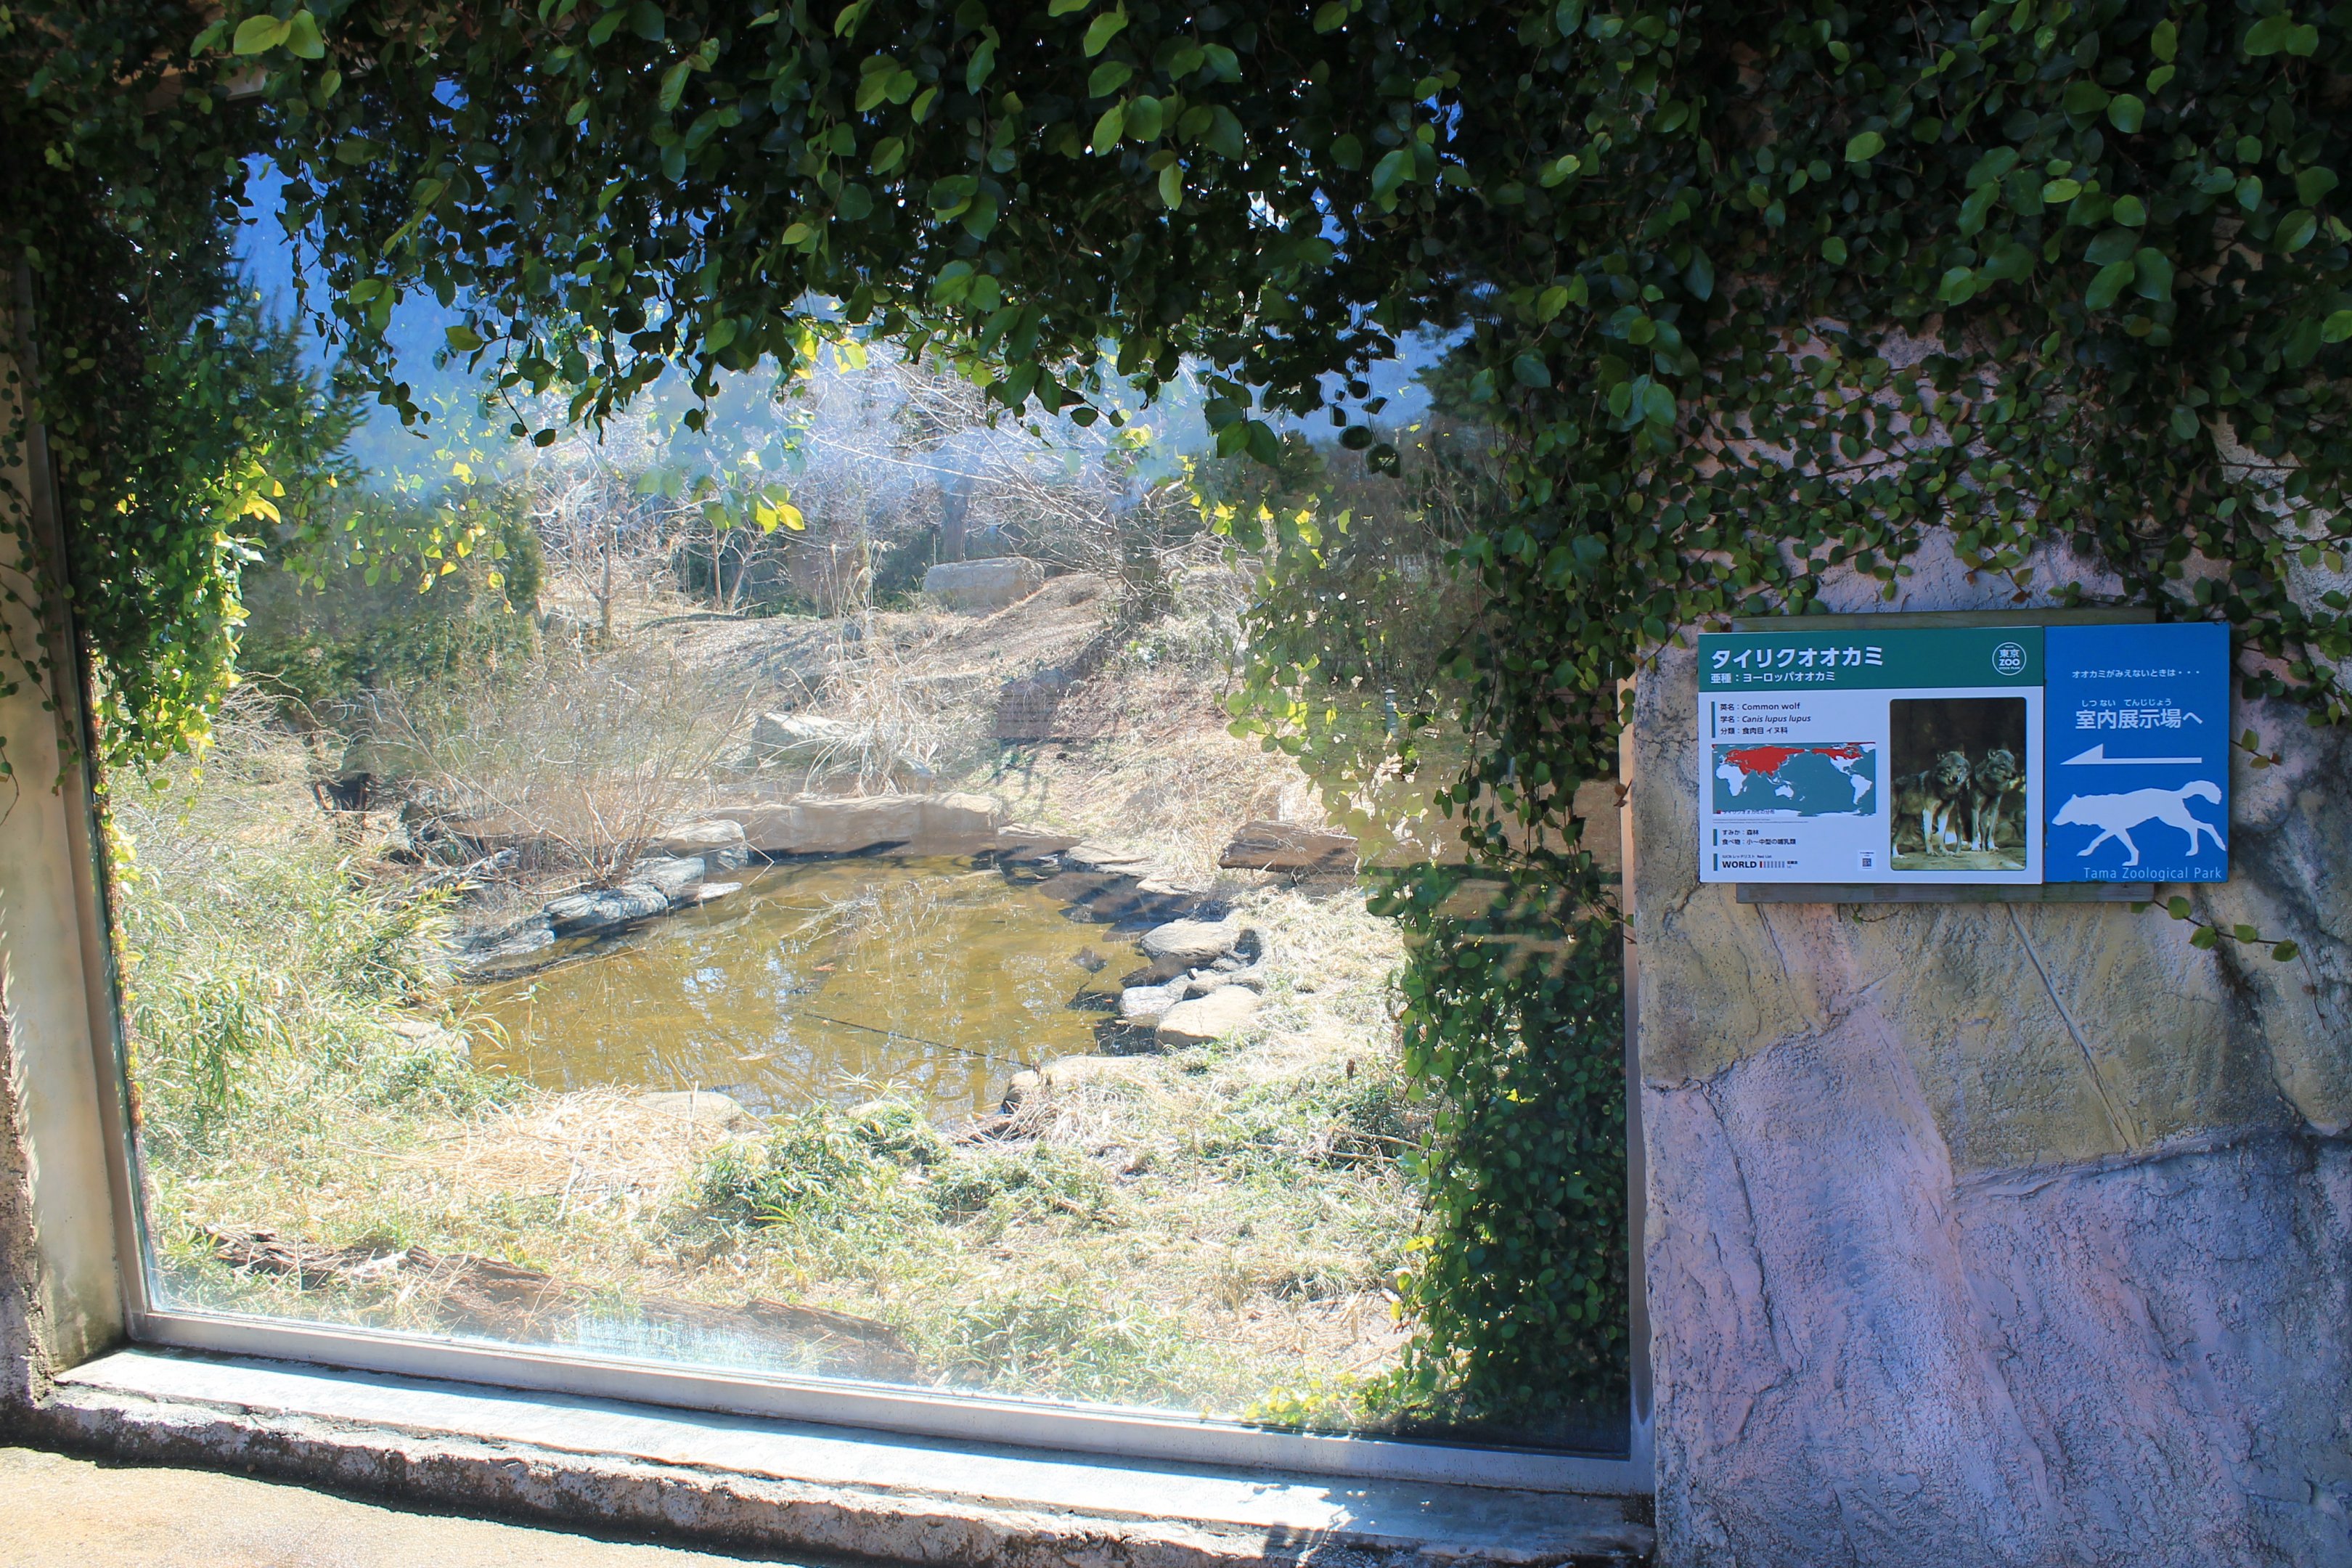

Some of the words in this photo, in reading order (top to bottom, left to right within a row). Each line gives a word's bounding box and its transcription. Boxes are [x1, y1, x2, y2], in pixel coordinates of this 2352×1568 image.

[1710, 645, 1884, 669] タイリクオオカミ
[1998, 649, 2020, 658] 東京
[2123, 698, 2172, 706] てんじじょう
[1765, 715, 1787, 724] lupus
[1789, 714, 1811, 724] lupus
[2075, 709, 2202, 730] 室内展示場へ
[2083, 867, 2117, 878] Tama
[2123, 867, 2188, 881] Zoological
[2194, 867, 2222, 878] Park
